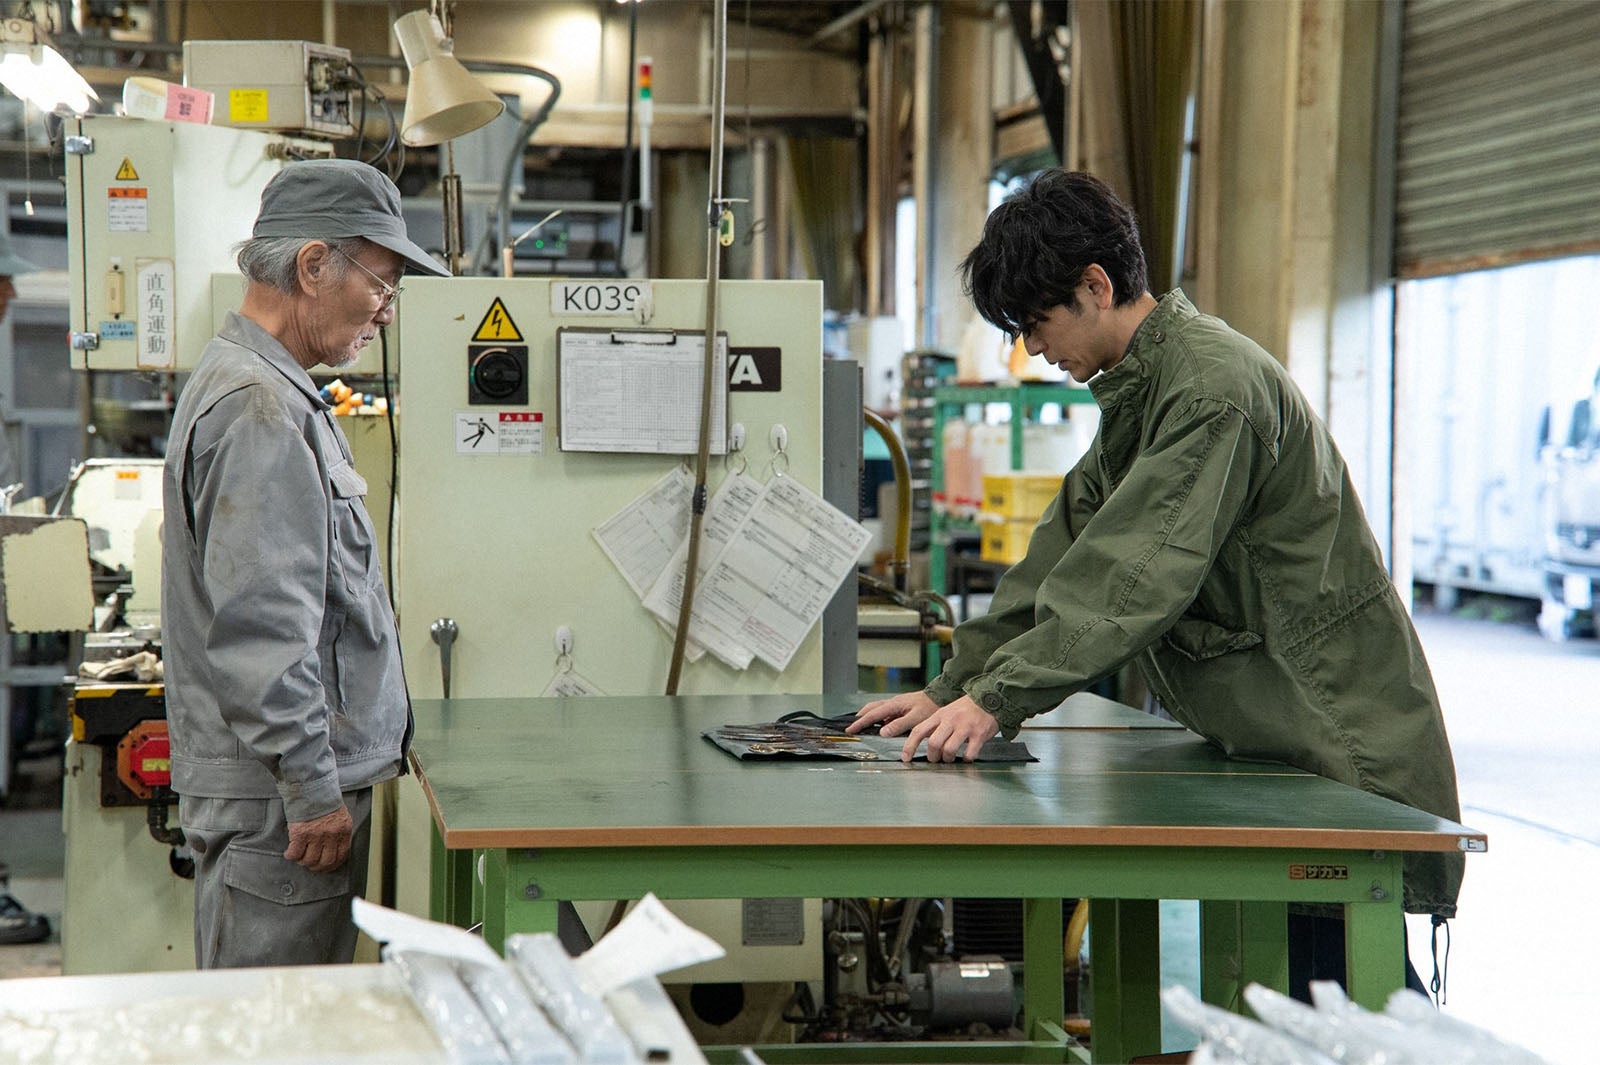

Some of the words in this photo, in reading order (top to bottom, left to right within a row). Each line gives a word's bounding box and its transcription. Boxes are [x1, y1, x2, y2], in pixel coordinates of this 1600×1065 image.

[564, 286, 641, 311] K039
[146, 272, 166, 354] 直角運動
[1307, 866, 1347, 879] サカエ
